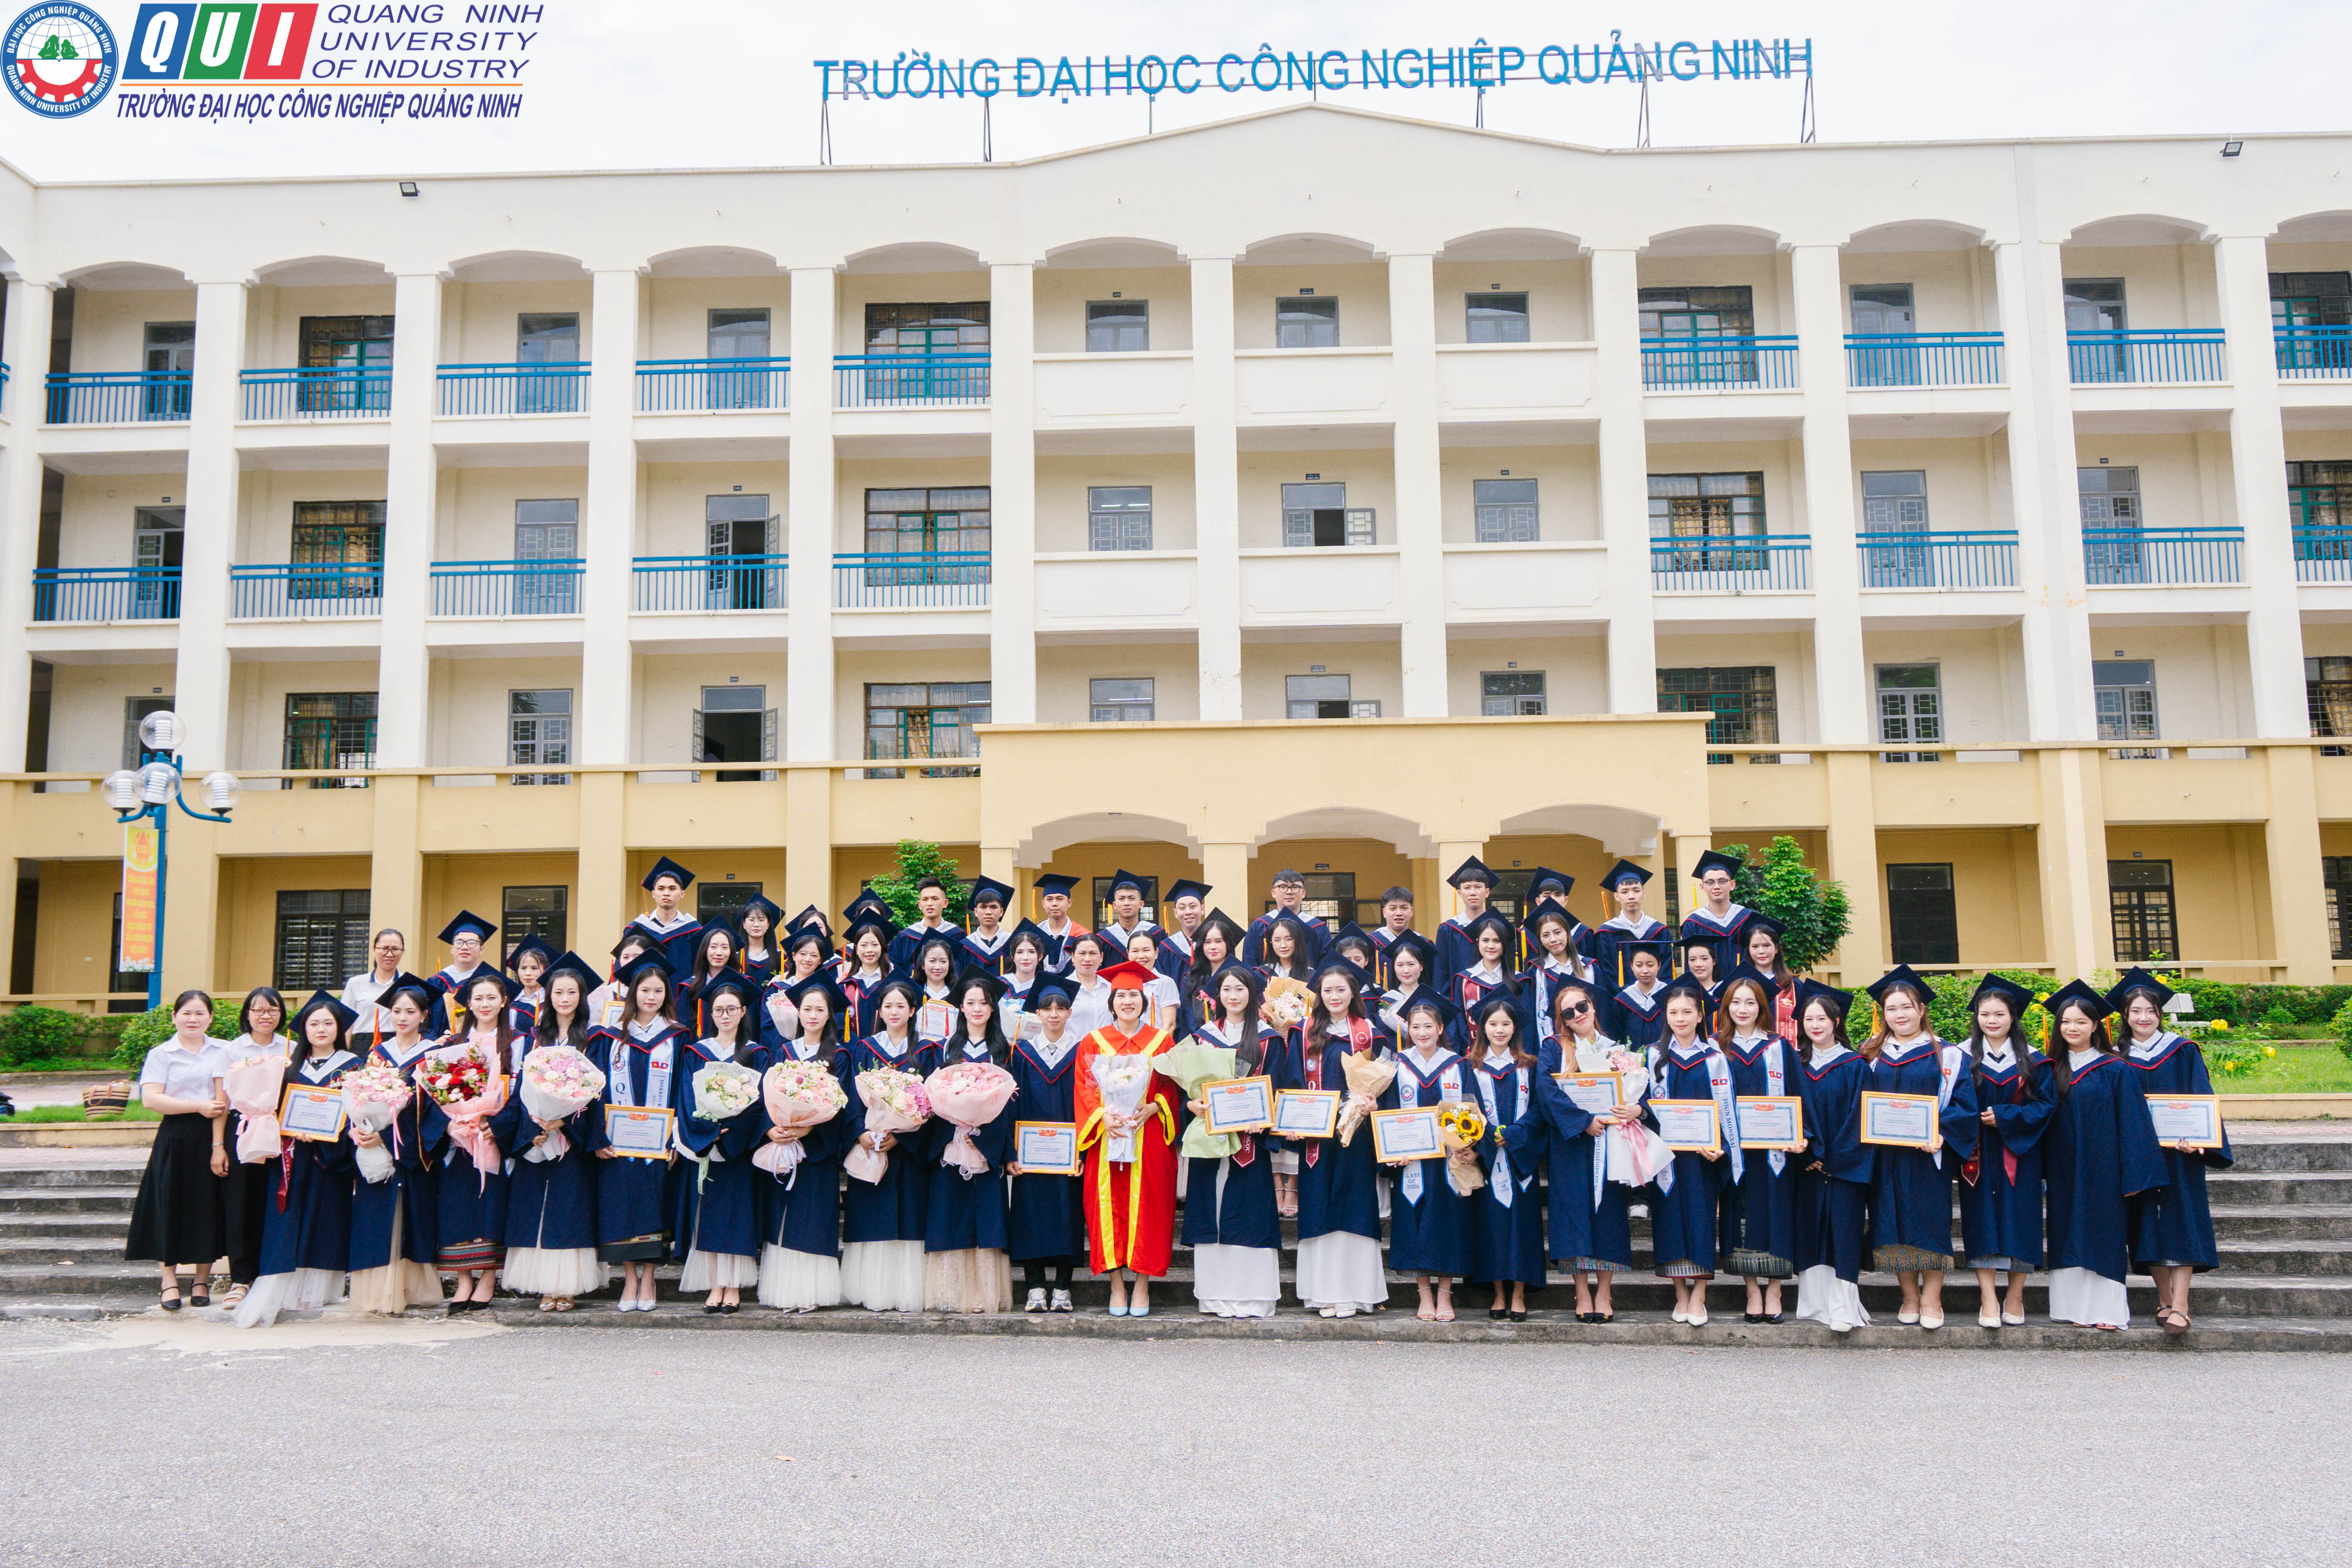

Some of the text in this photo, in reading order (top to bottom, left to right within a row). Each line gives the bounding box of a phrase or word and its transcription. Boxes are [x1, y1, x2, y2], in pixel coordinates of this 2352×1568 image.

[813, 29, 1812, 104] TRƯỜNG ĐẠI HỌC CÔNG NGHIỆP QUẢNG NINH
